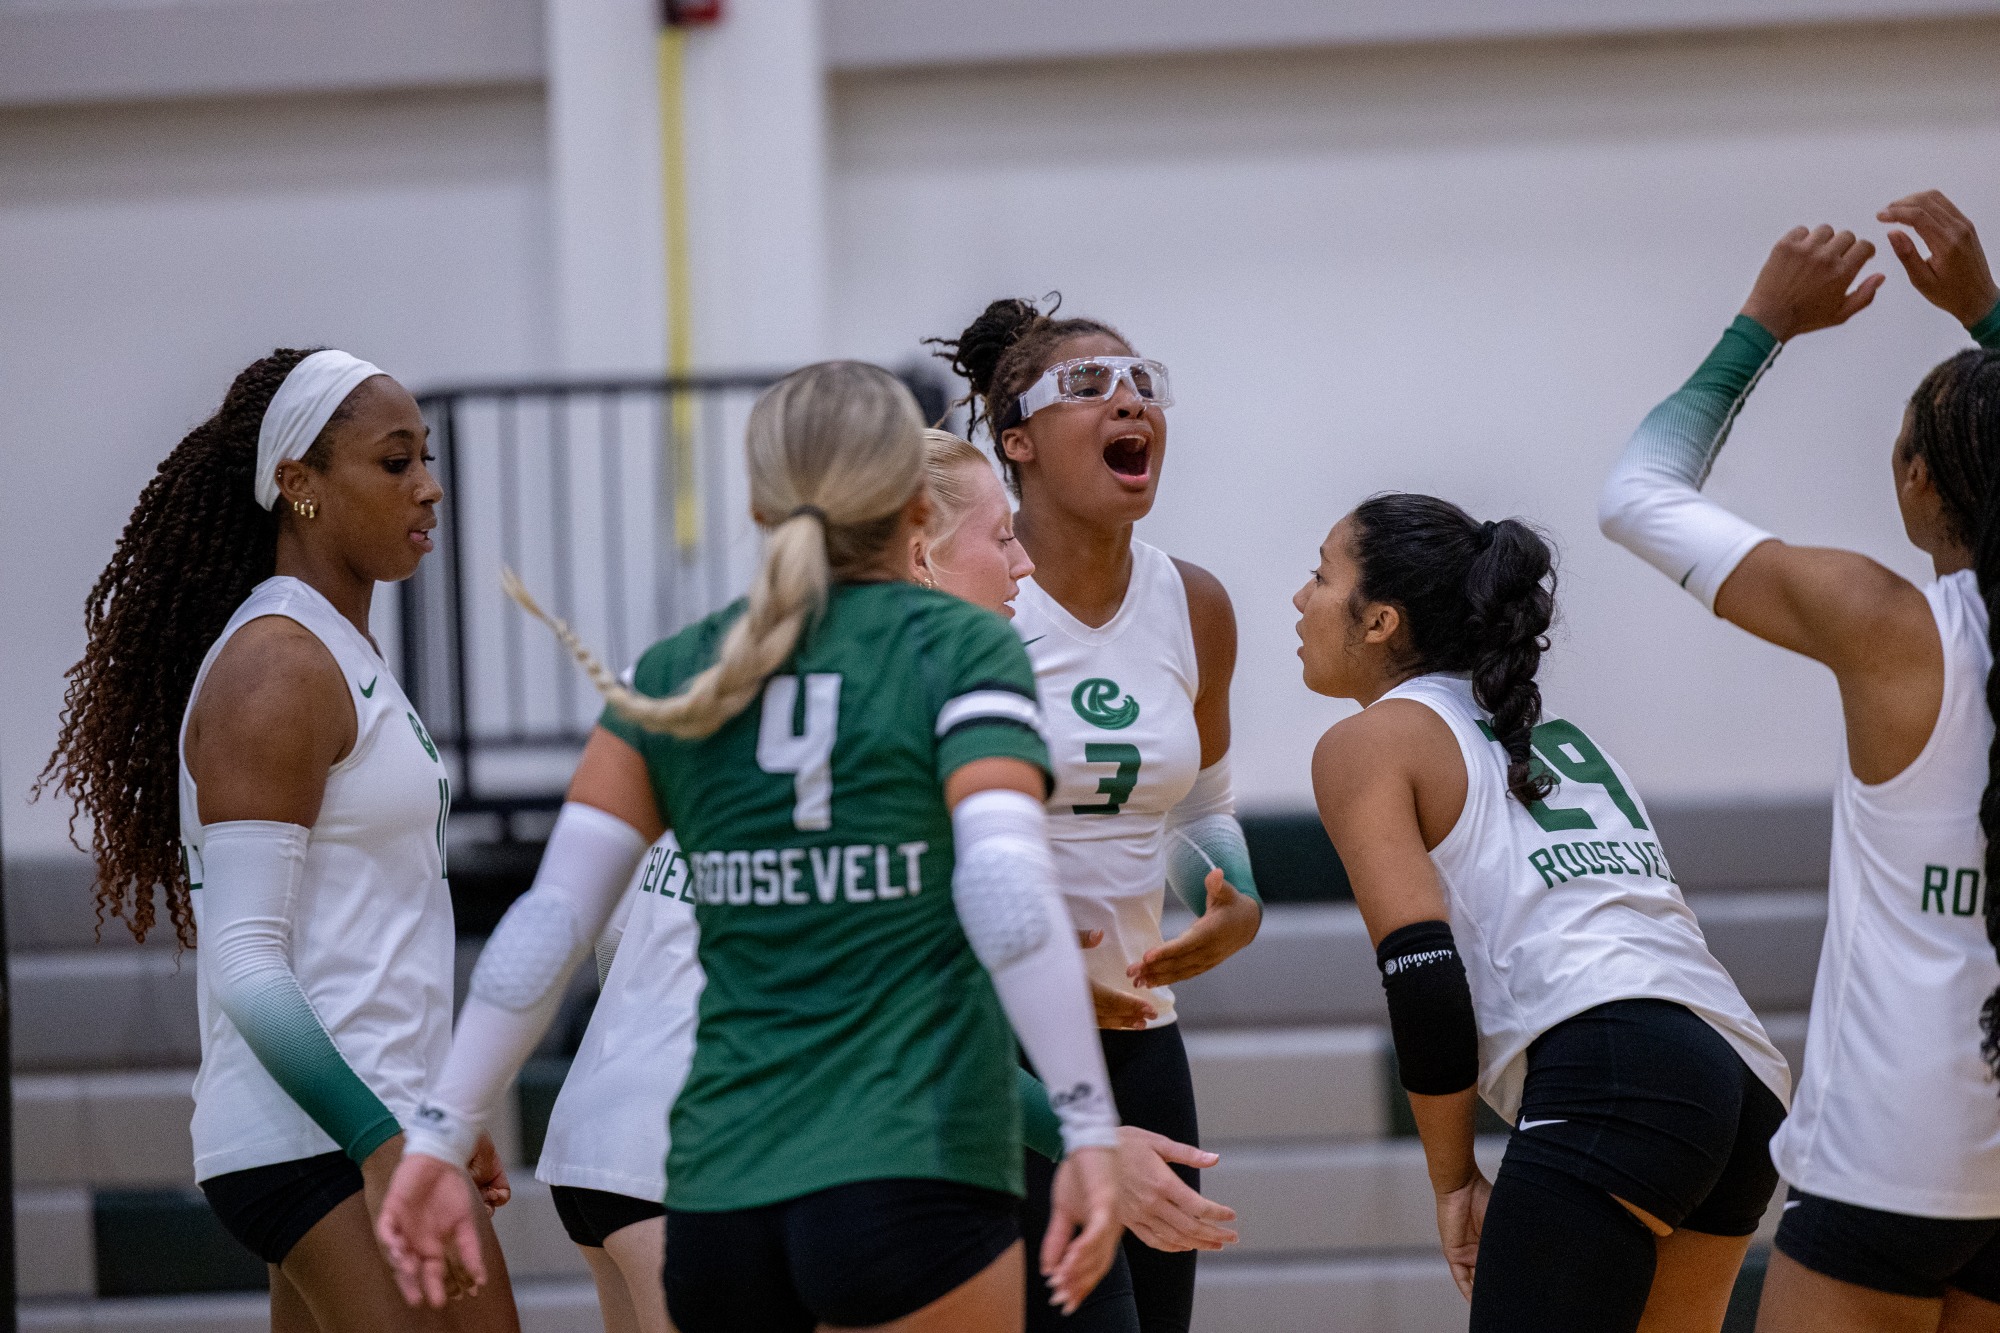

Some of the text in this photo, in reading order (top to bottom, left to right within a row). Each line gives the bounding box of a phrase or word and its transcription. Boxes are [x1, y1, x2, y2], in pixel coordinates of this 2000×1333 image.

[756, 672, 843, 831] 4
[1072, 743, 1141, 815] 3
[1474, 718, 1649, 832] 29
[690, 840, 928, 906] ROOSEVELT
